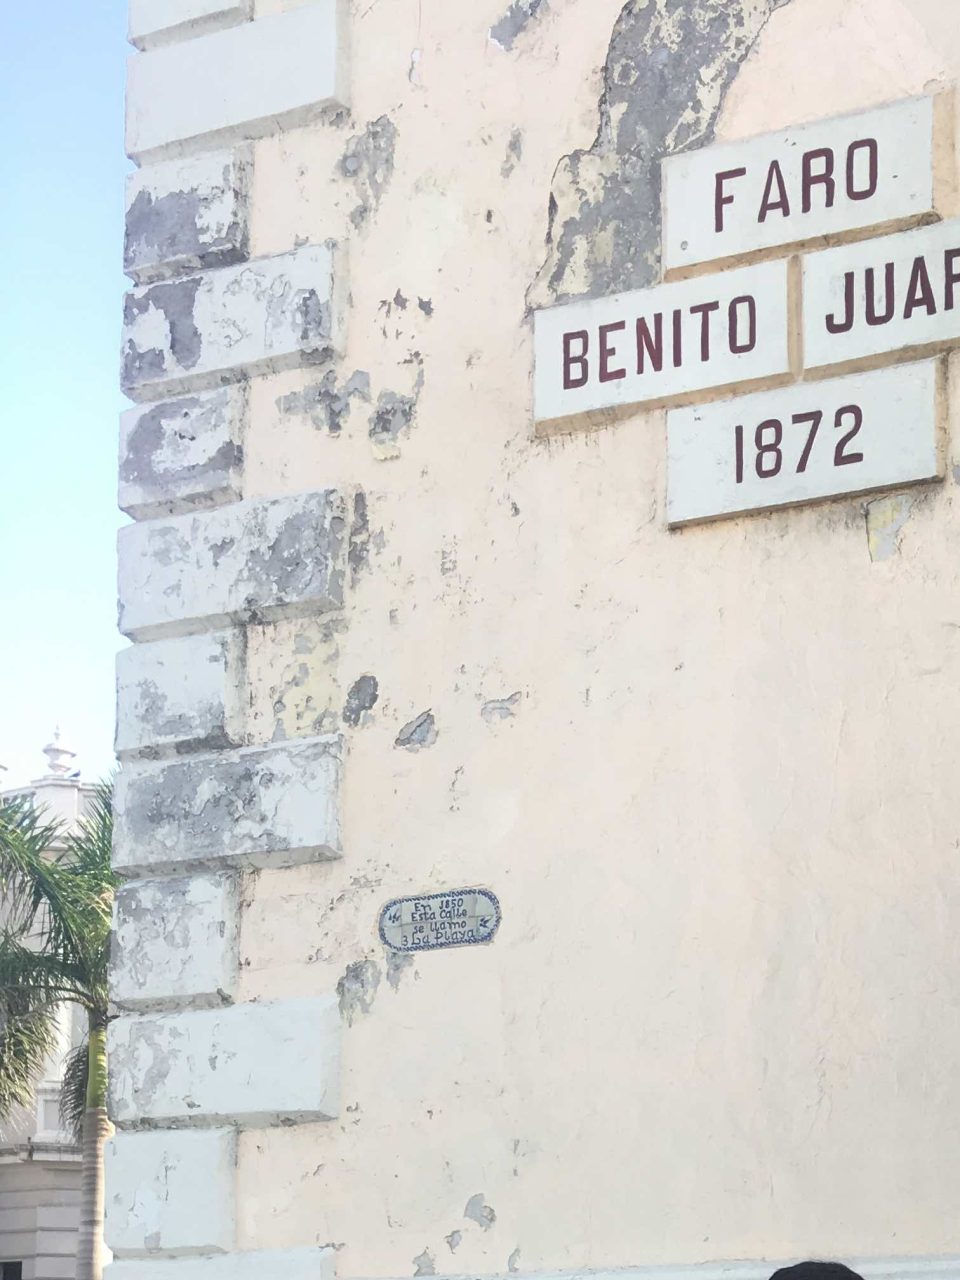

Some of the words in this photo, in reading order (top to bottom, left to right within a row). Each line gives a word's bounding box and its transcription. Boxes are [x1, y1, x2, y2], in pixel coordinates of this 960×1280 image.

[714, 138, 878, 233] FARO
[562, 294, 757, 391] BENITO
[734, 403, 864, 484] 1872
[414, 902, 432, 912] En
[411, 911, 436, 922] Esta
[414, 924, 424, 934] se
[435, 929, 476, 942] Playa
